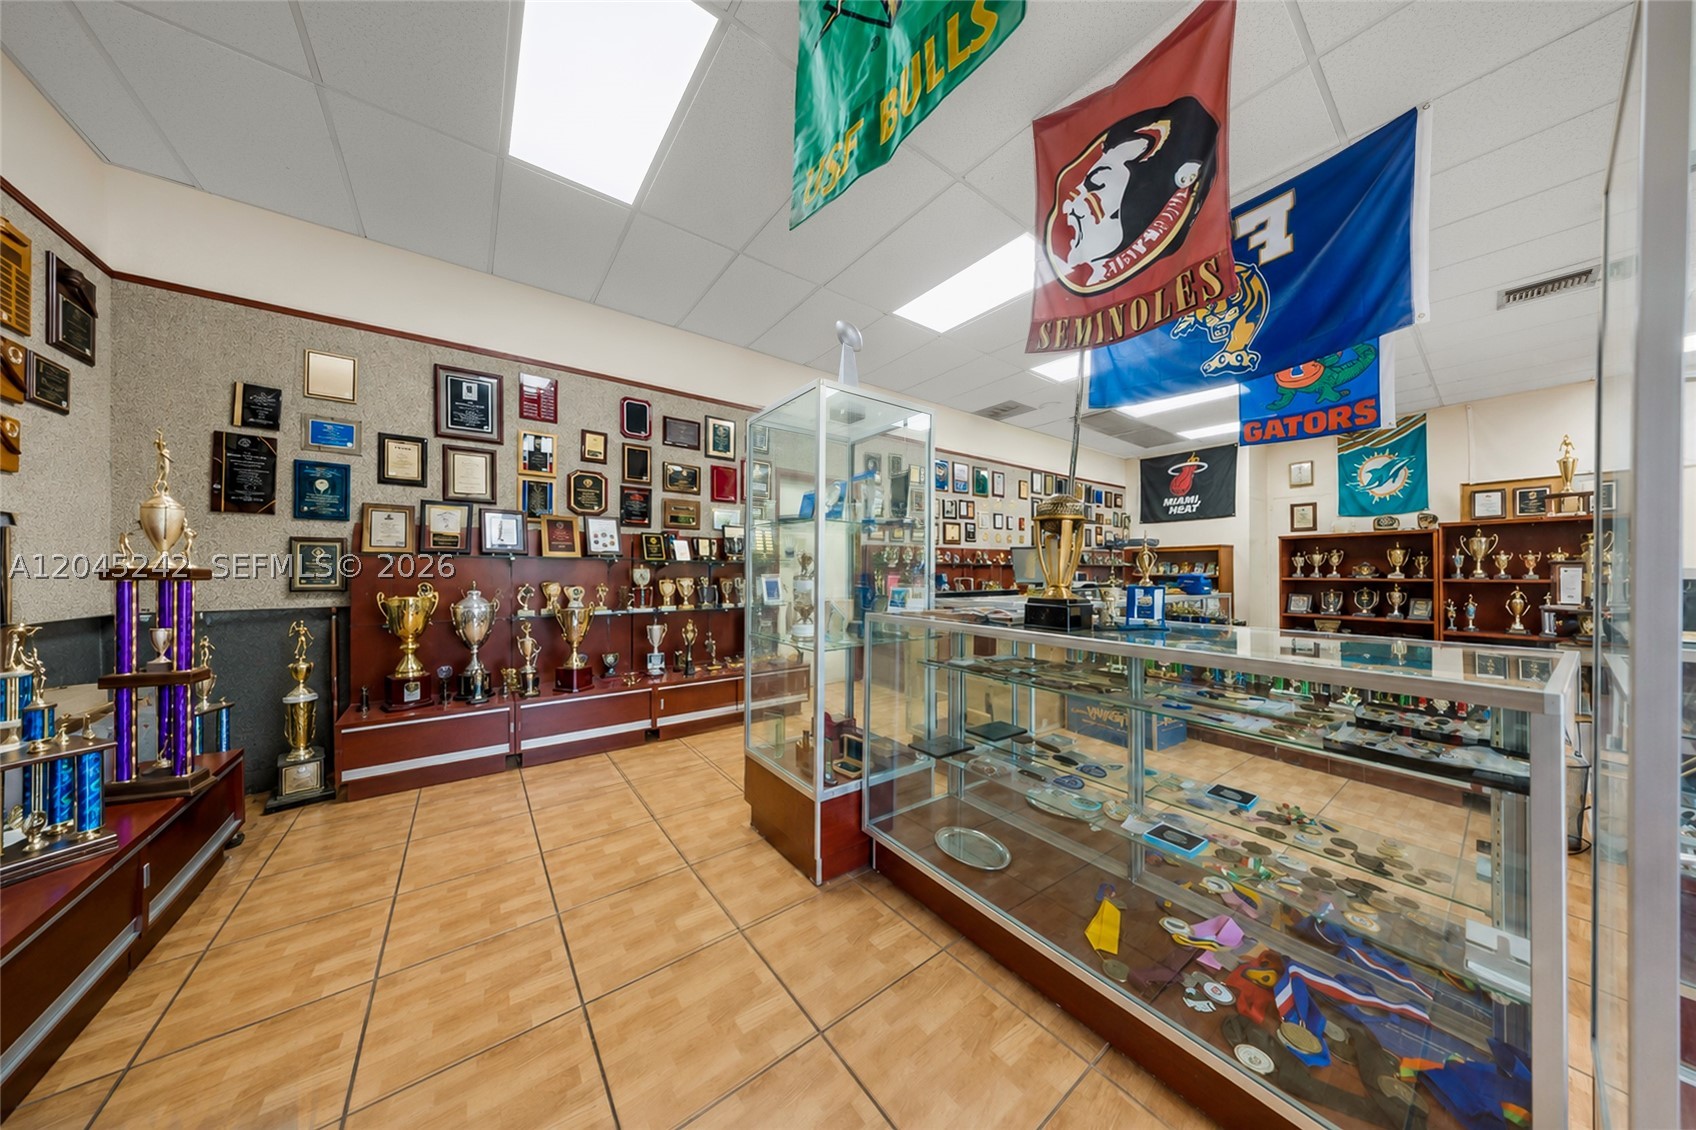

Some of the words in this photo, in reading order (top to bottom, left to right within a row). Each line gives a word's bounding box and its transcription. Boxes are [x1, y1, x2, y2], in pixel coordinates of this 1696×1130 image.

[803, 117, 864, 206] USF
[880, 0, 998, 146] BULLS
[1036, 256, 1226, 350] SEMINOLES
[1242, 398, 1378, 443] GATORS
[1163, 495, 1199, 506] MIAMI
[1169, 501, 1201, 514] HEAT
